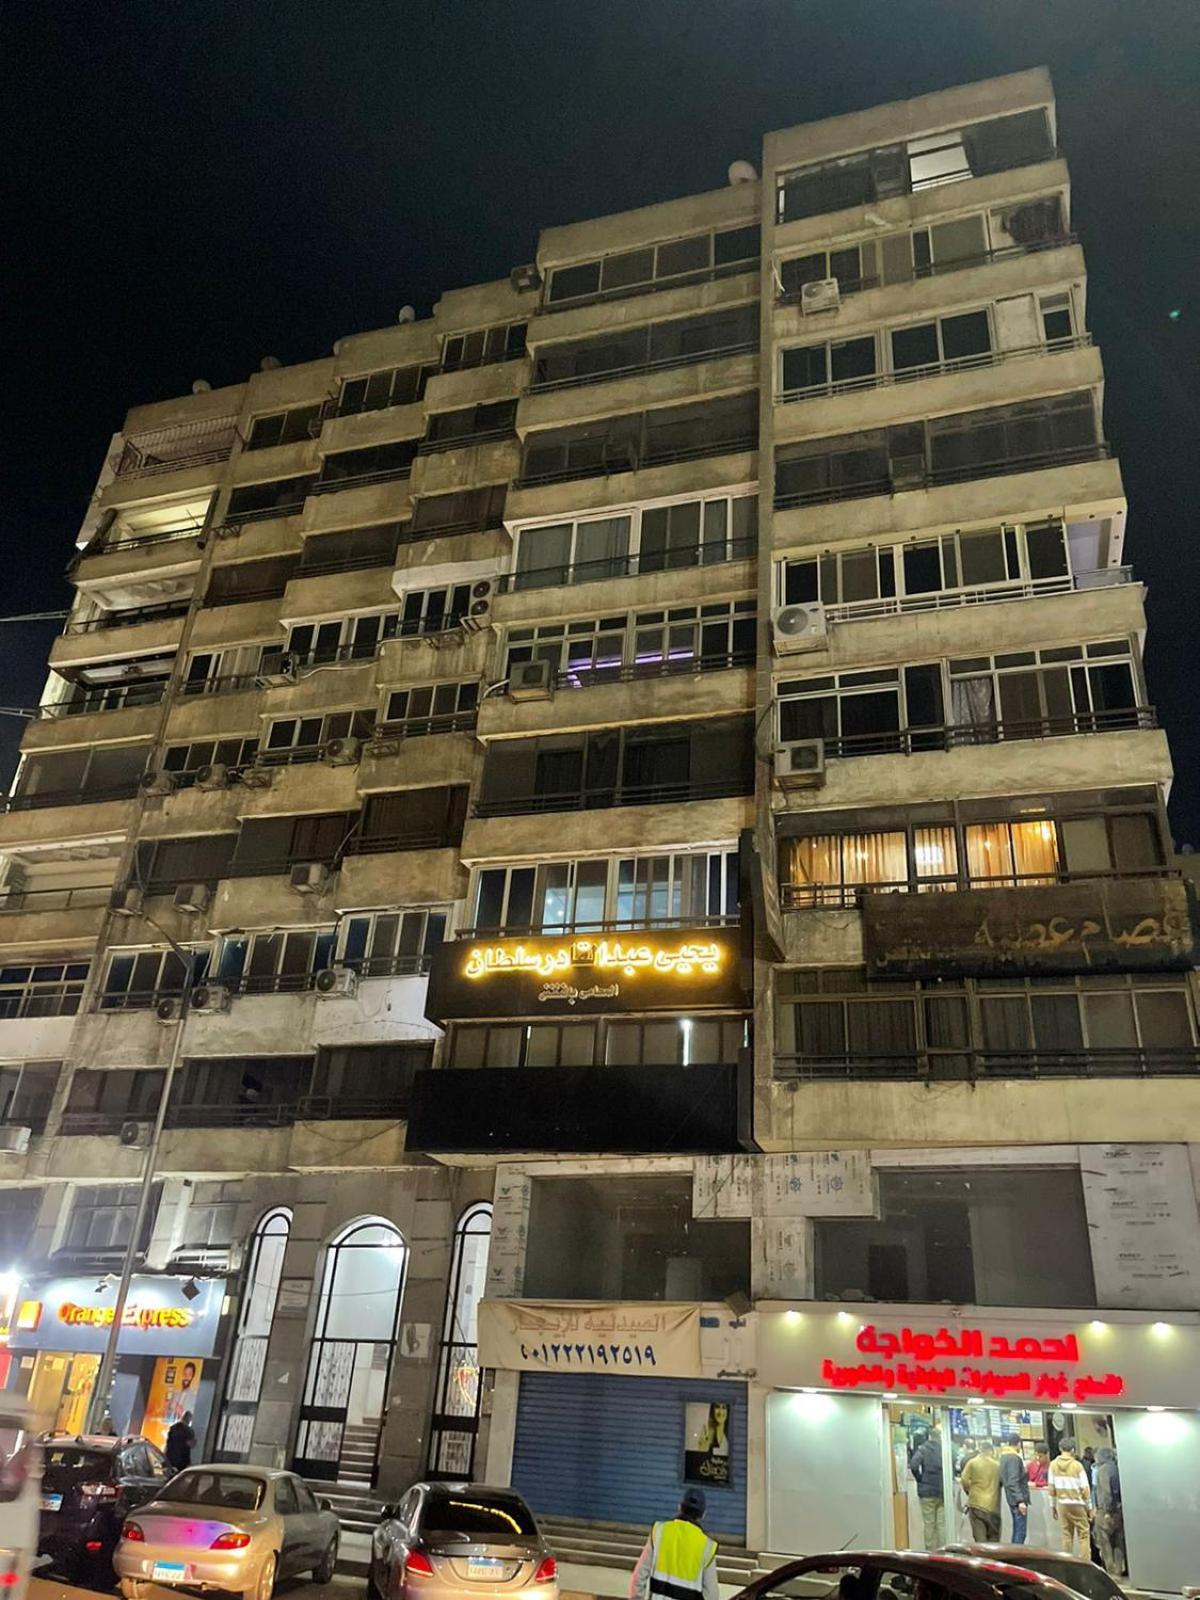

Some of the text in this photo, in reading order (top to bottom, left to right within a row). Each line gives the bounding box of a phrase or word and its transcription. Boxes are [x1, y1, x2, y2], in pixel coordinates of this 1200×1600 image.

[464, 945, 540, 978] سلطان
[654, 942, 721, 973] يحيى
[56, 1301, 193, 1331] Orange Express
[856, 1325, 1079, 1362] احمد الخواجة
[960, 1366, 1031, 1397] السيارات
[1033, 1371, 1069, 1401] غيار
